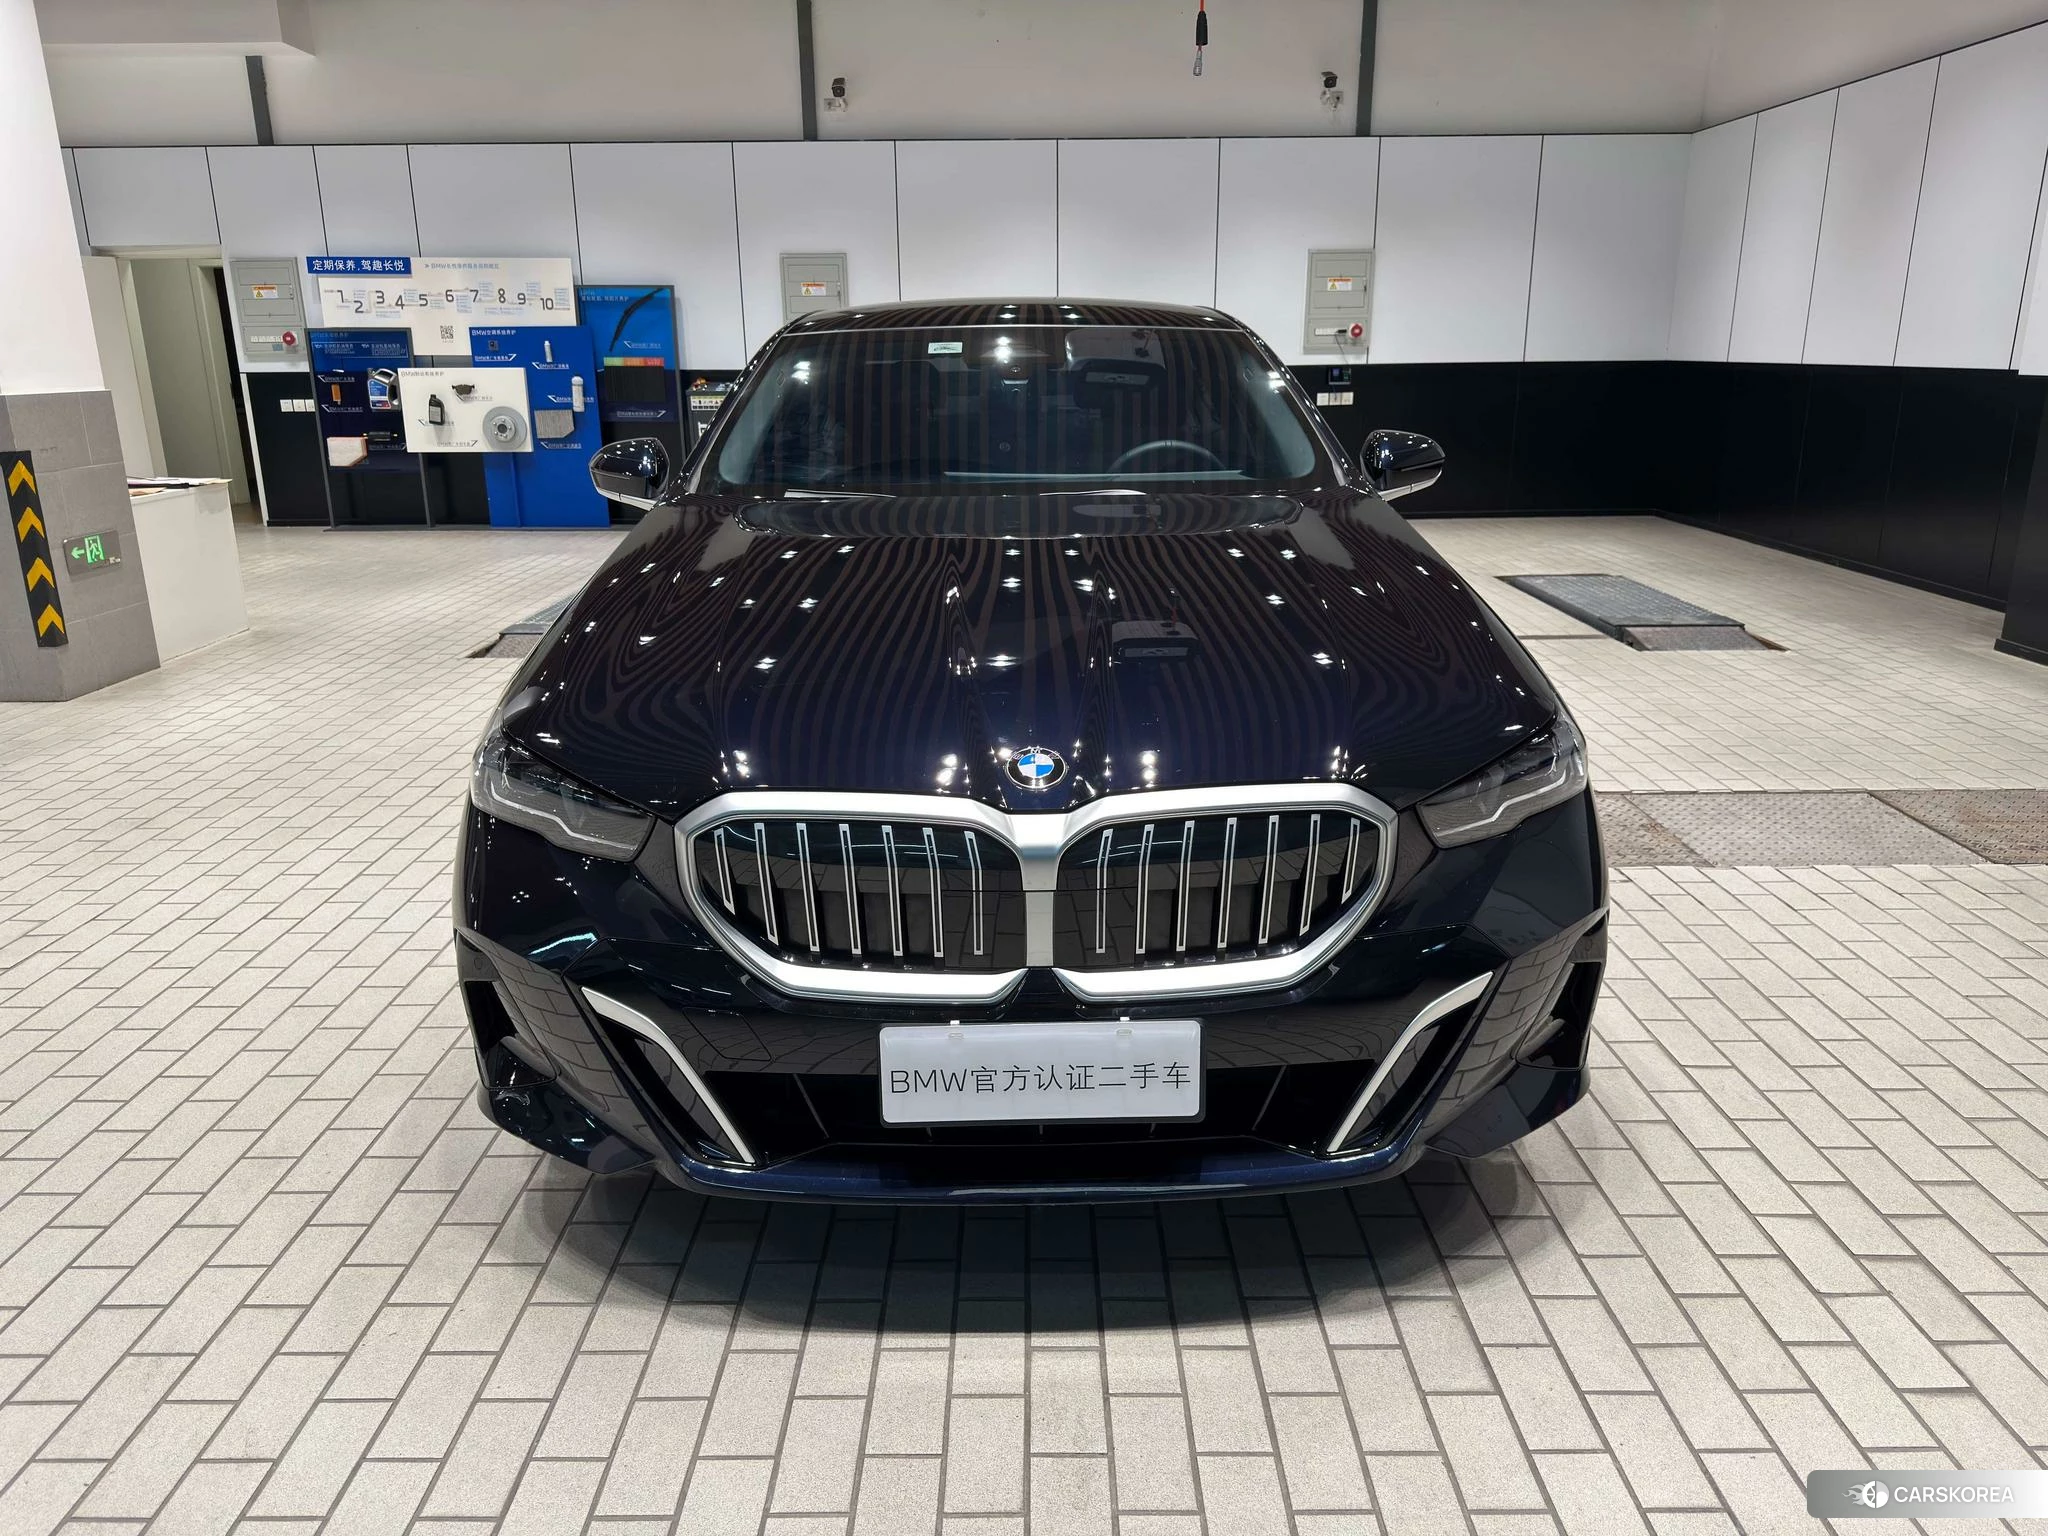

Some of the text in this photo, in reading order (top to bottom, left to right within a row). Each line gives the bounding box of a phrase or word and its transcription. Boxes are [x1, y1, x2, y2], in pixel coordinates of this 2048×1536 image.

[312, 259, 405, 272] 定期保养,驾趣长悦
[353, 300, 364, 314] 2
[375, 290, 385, 304] 3
[395, 295, 405, 310] 4
[419, 294, 429, 306] 5
[445, 289, 455, 302] 6
[470, 289, 479, 303] 7
[498, 288, 506, 304] 8
[517, 293, 526, 305] 9
[540, 298, 554, 310] 10
[890, 1061, 1191, 1094] BMW官方认证二手车
